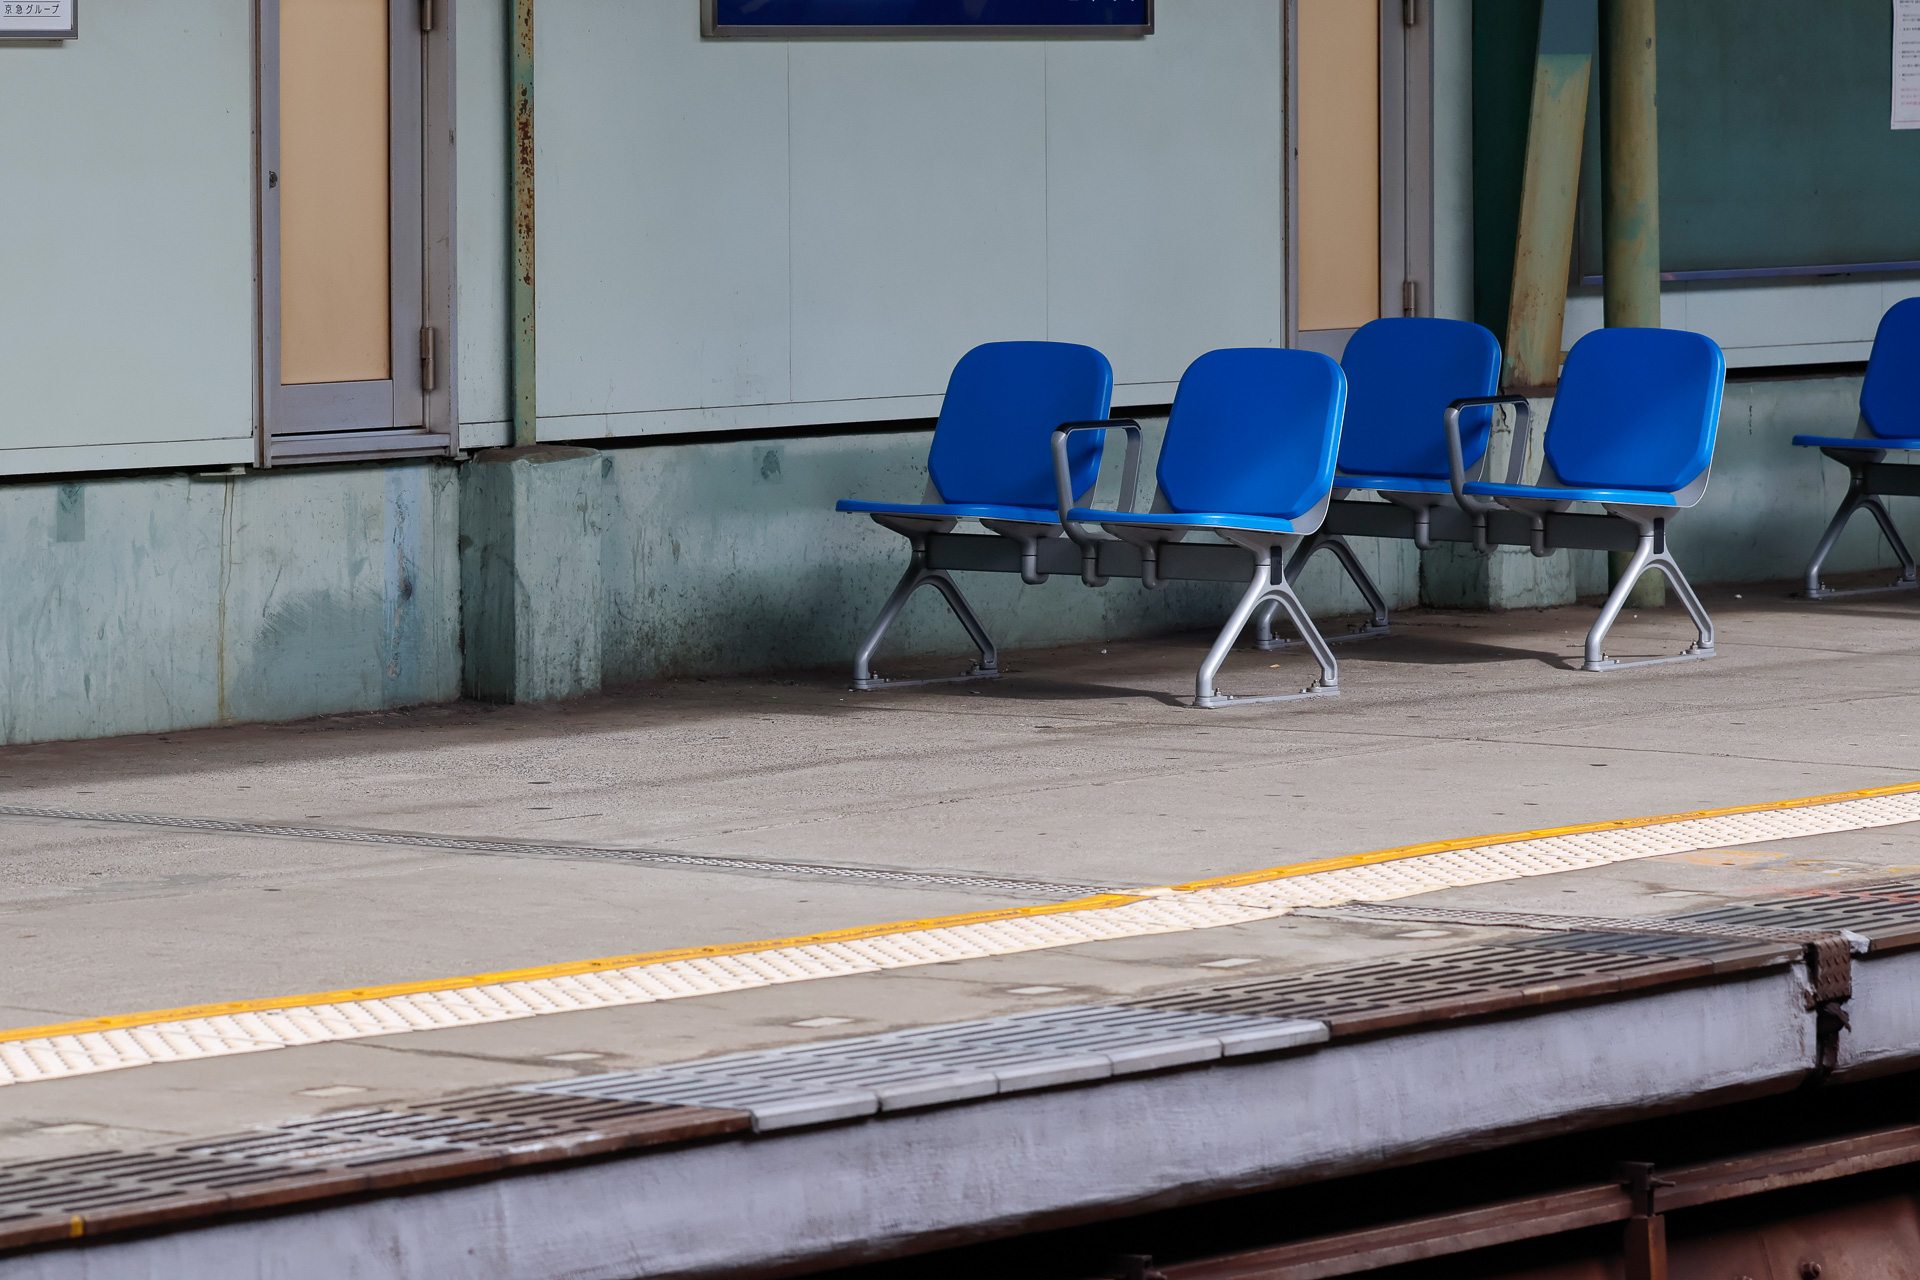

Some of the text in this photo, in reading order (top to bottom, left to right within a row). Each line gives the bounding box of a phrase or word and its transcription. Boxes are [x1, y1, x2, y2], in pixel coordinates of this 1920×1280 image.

[5, 4, 59, 14] 京急グループ
